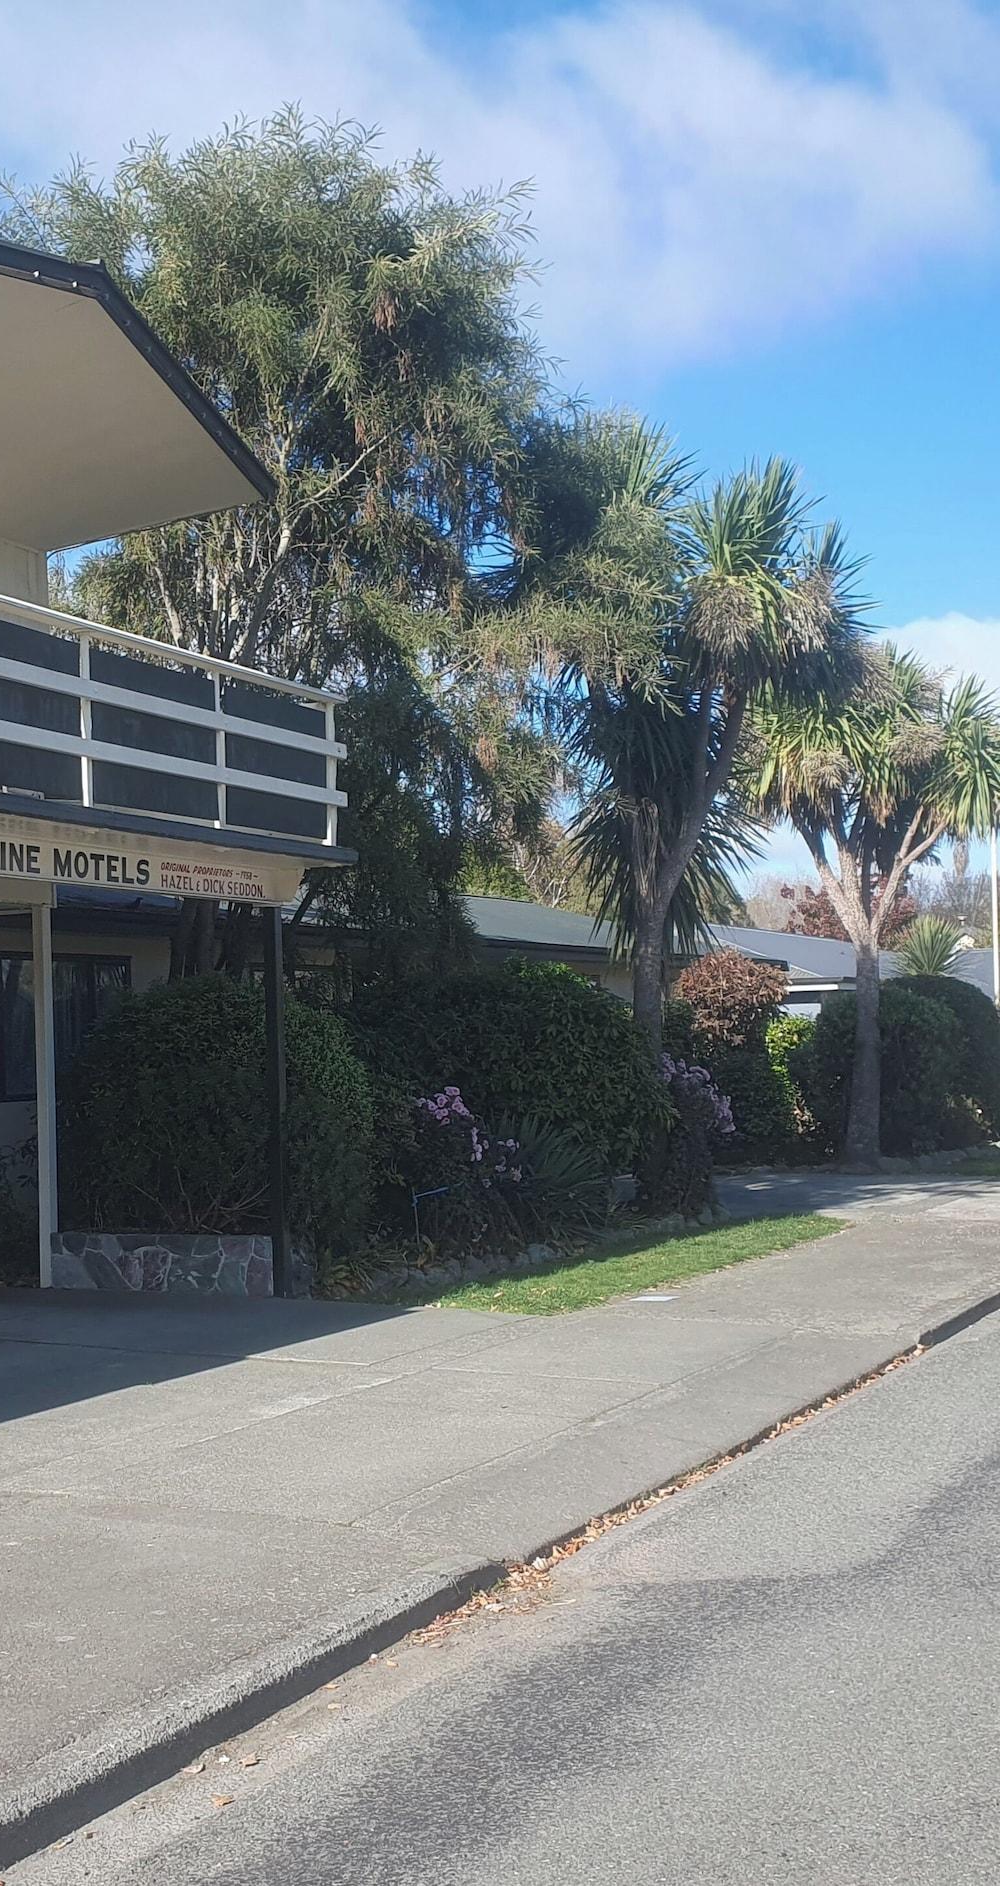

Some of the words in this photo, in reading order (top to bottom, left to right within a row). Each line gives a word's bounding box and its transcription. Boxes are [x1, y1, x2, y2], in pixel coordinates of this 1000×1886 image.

[53, 847, 150, 886] MOTELS
[160, 862, 191, 874] ORIGINAL
[192, 865, 234, 878] PROPRIETORS
[160, 873, 194, 891] HAZEL
[203, 878, 226, 895] DICK
[227, 881, 267, 898] SEDDON.
